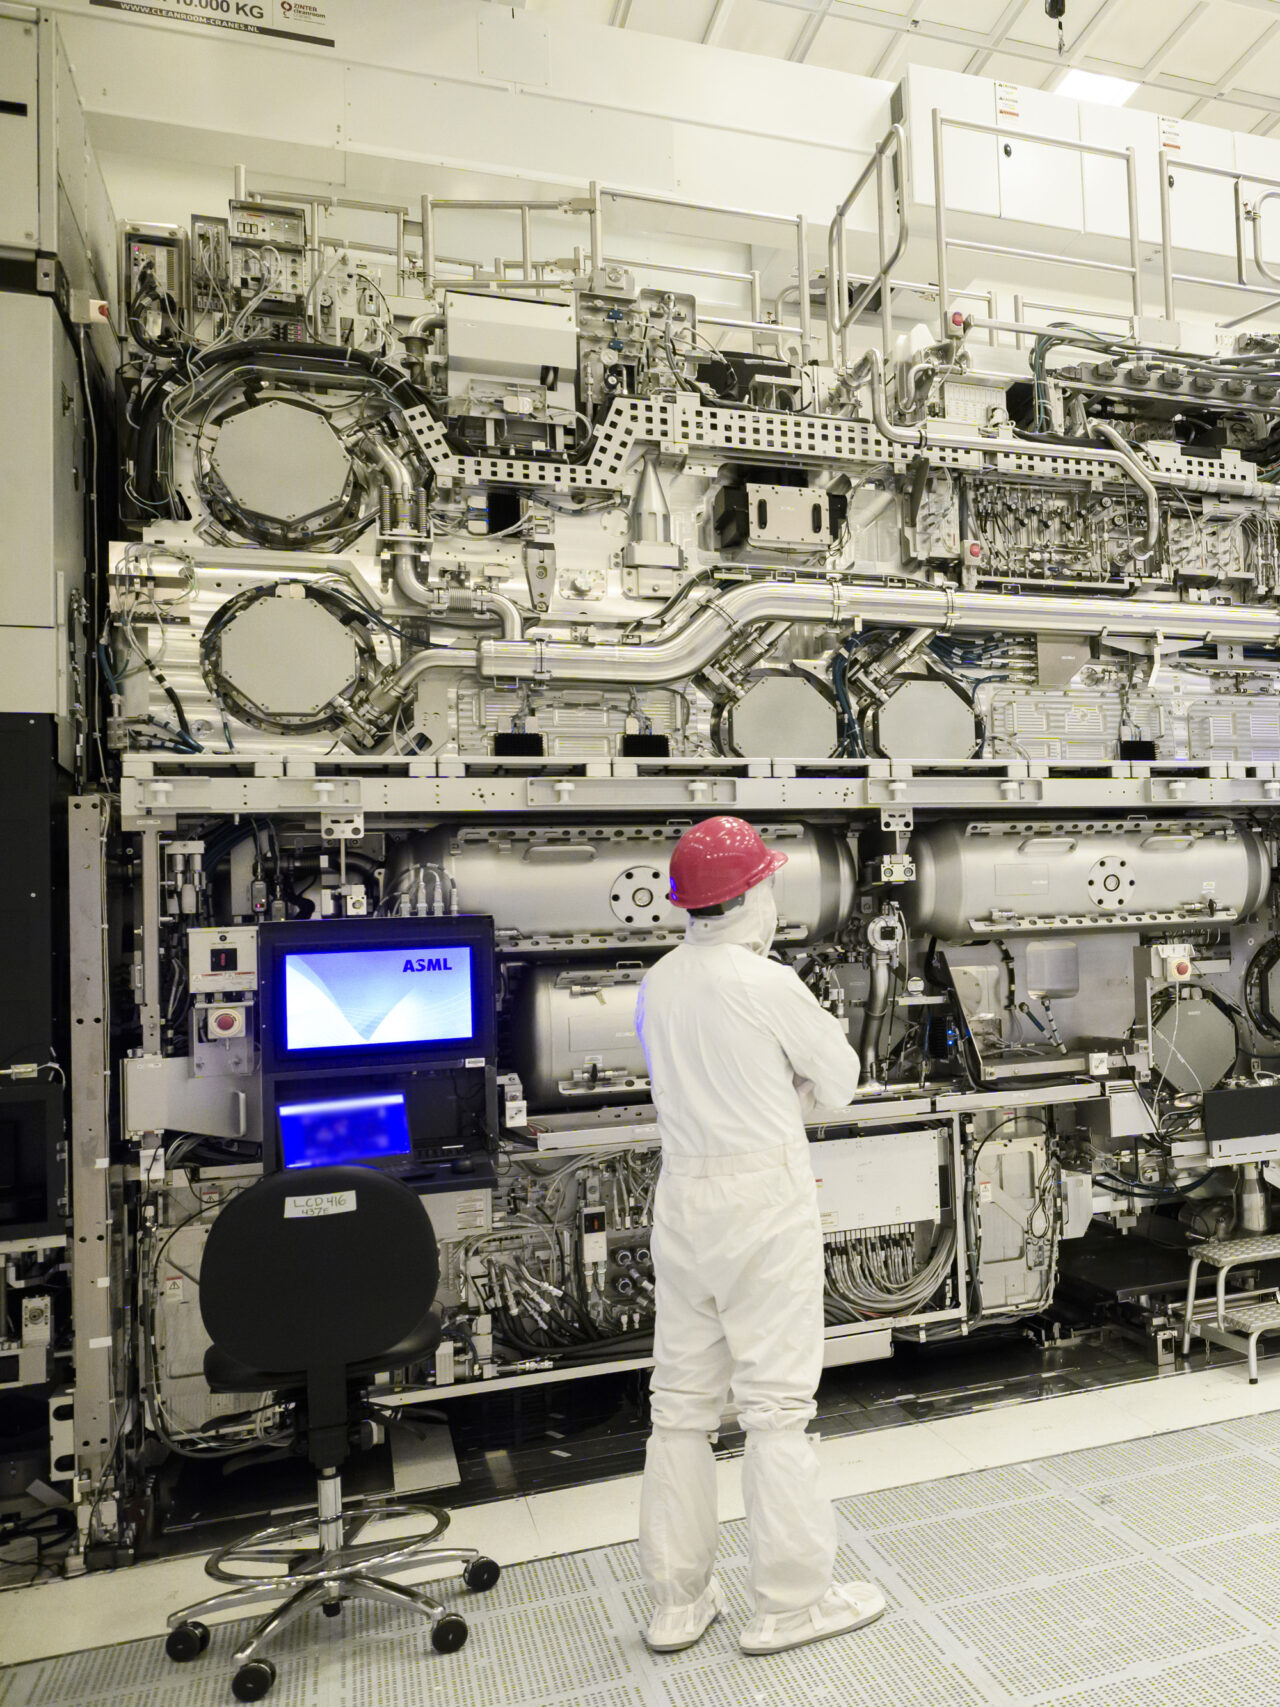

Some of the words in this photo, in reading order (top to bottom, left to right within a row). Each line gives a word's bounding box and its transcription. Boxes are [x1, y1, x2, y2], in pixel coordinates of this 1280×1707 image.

[120, 2, 260, 33] WWW.CLEANROOM-CRANES.NL
[236, 2, 264, 19] KG
[402, 958, 452, 973] ASML
